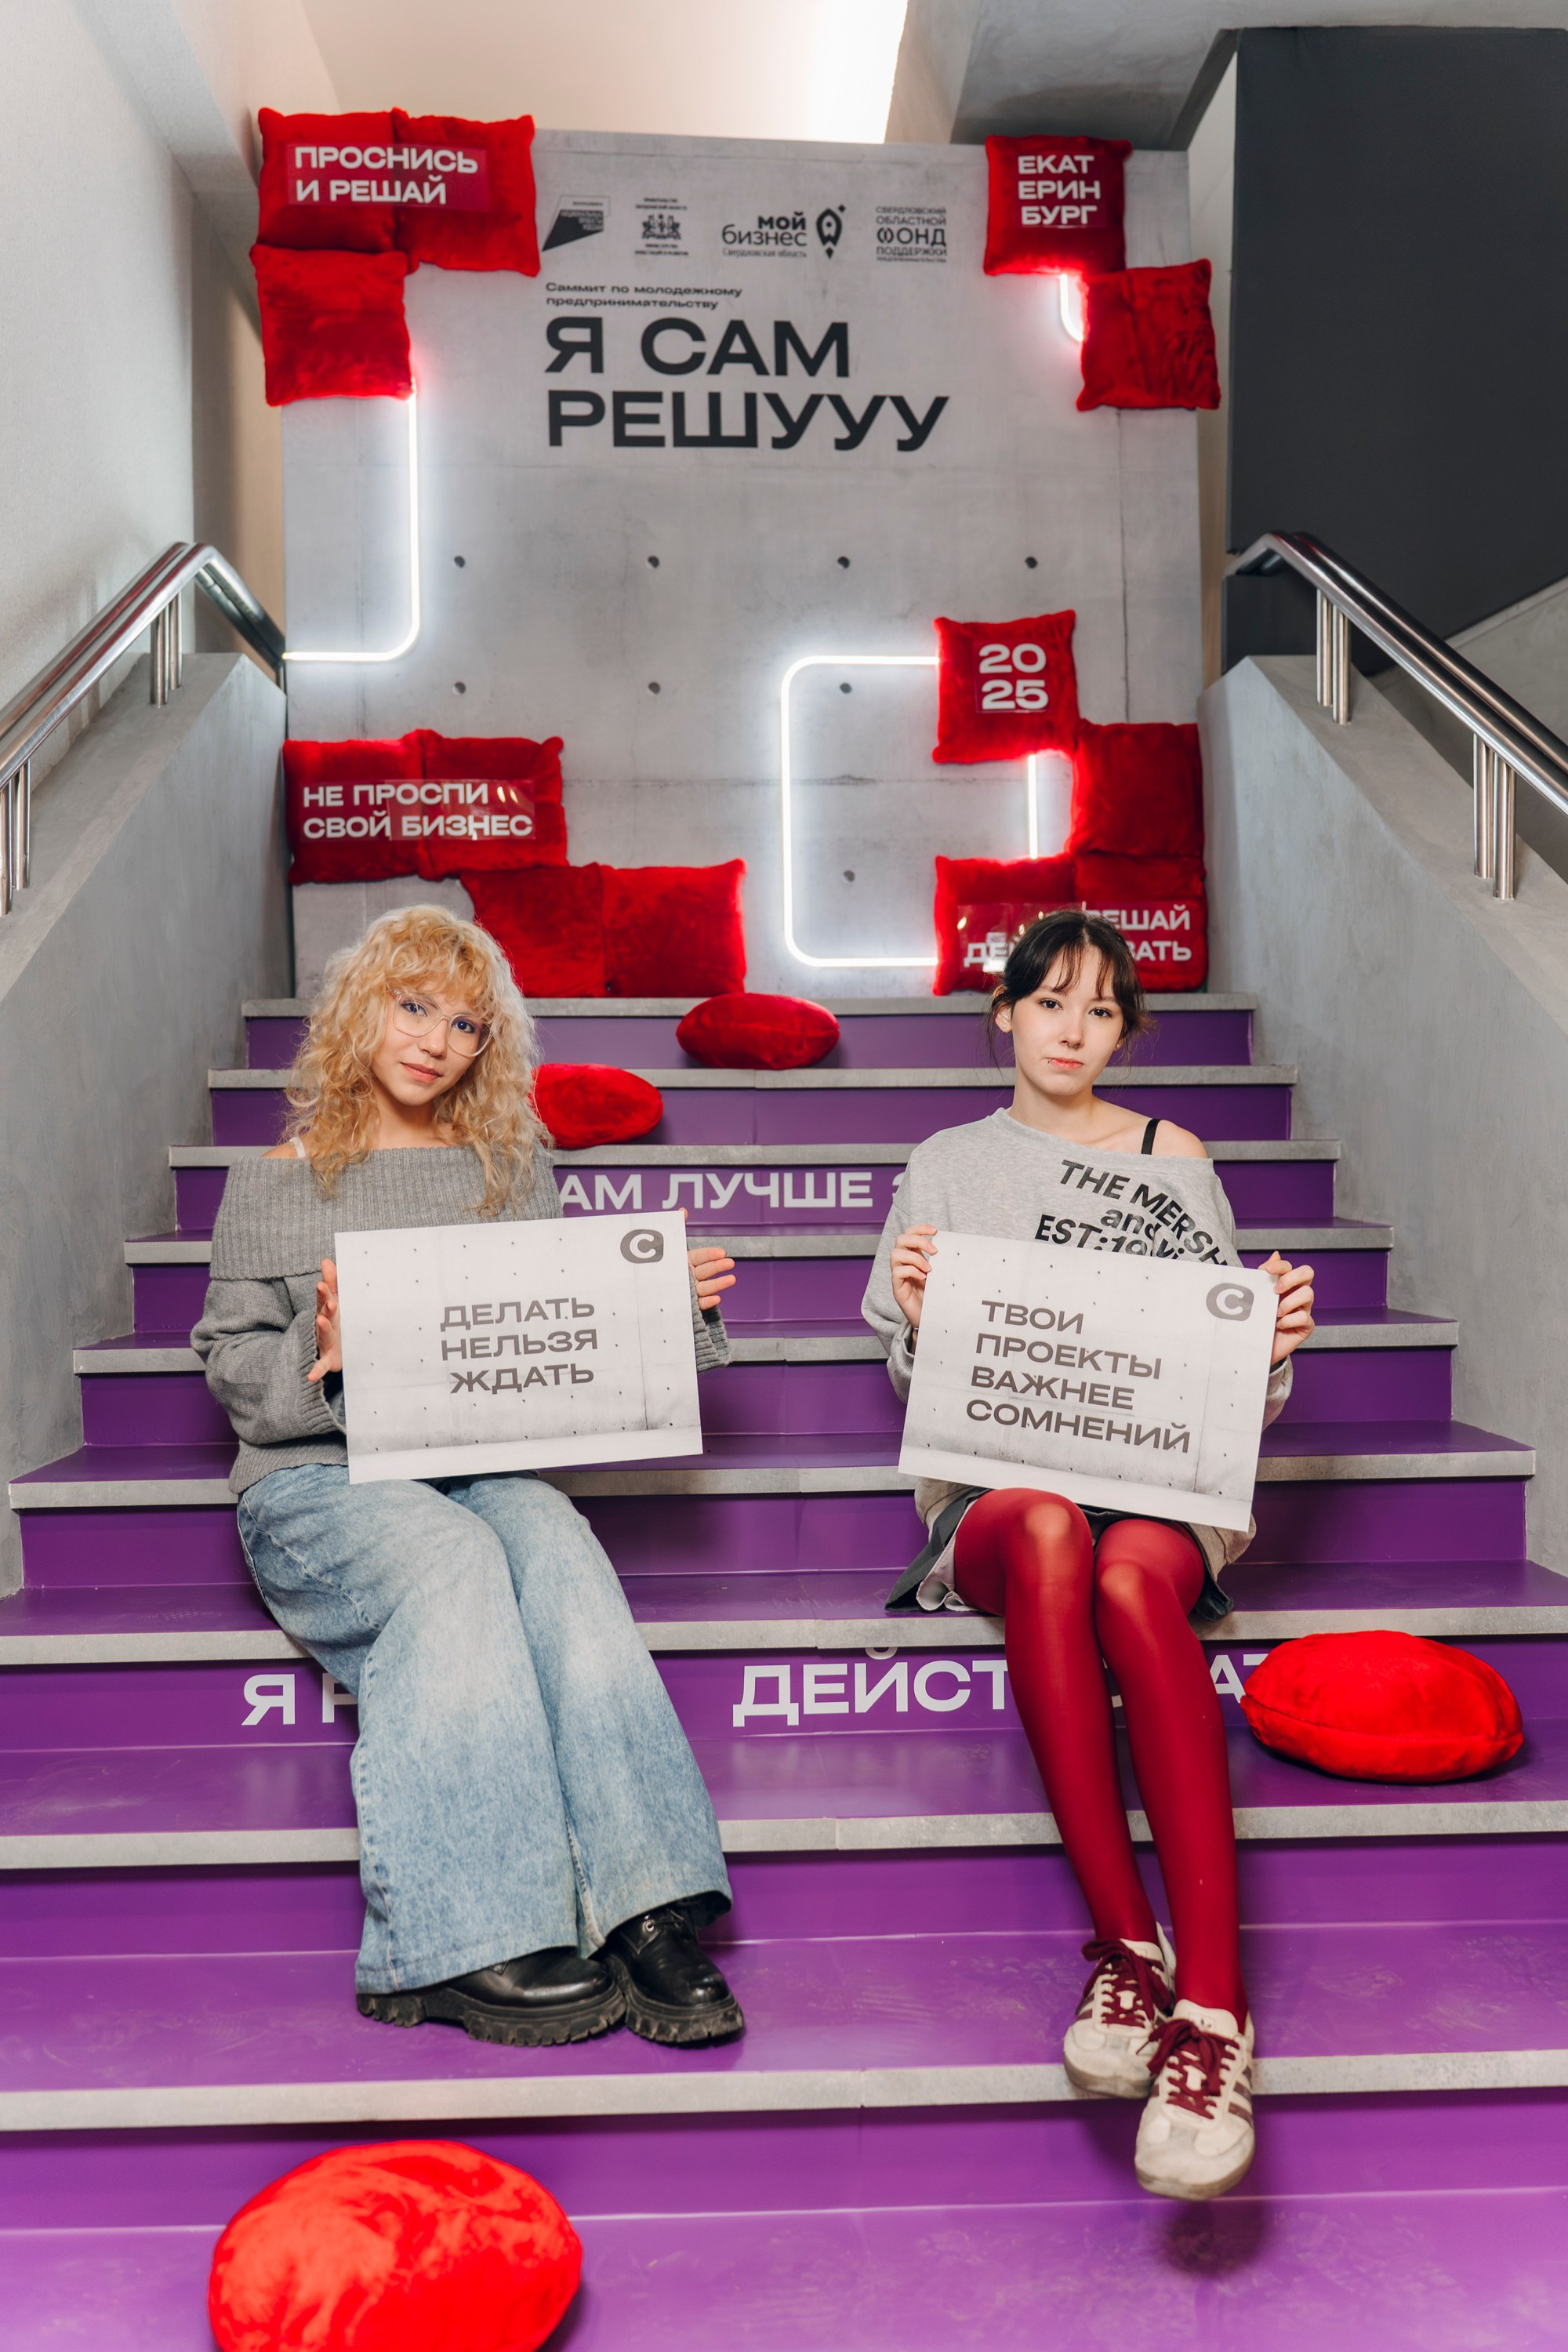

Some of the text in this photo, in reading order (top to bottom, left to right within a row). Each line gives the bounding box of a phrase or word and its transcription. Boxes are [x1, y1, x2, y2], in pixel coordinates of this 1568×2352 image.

[295, 146, 478, 174] ПРОСНИСЬ
[1018, 154, 1094, 175] ЕКАТ
[296, 175, 447, 205] И РЕШАЙ
[1018, 180, 1101, 200] ЕРИН
[757, 210, 806, 230] мой
[876, 214, 946, 226] ОБЛАСТНОЙ
[1021, 205, 1098, 226] БУРГ
[722, 223, 808, 246] бизнес
[877, 227, 946, 246] ФОНД
[877, 246, 947, 256] ПОДДЕРЖКИ
[546, 282, 742, 297] Саммит по молодежному
[546, 296, 719, 310] предпринимательству
[544, 316, 850, 378] Я САМ
[547, 390, 949, 452] РЕШУУУ
[978, 643, 1047, 673] 20
[982, 679, 1049, 710] 25
[303, 783, 488, 808] НЕ ПРОСПИ
[303, 811, 533, 839] СВОЙ БИЗНЕС
[559, 1174, 642, 1210] АМ
[662, 1171, 873, 1210] ЛУЧШЕ
[1060, 1160, 1131, 1200] THE
[440, 1297, 595, 1332] ДЕЛАТЬ
[982, 1300, 1083, 1334] ТВОИ
[441, 1329, 598, 1361] НЕЛЬЗЯ
[976, 1333, 1162, 1380] ПРОЕКТЫ
[450, 1363, 594, 1395] ЖДАТЬ
[971, 1365, 1134, 1410] ВАЖНЕЕ
[966, 1399, 1191, 1454] СОМНЕНИЙ
[241, 1673, 296, 1726] Я
